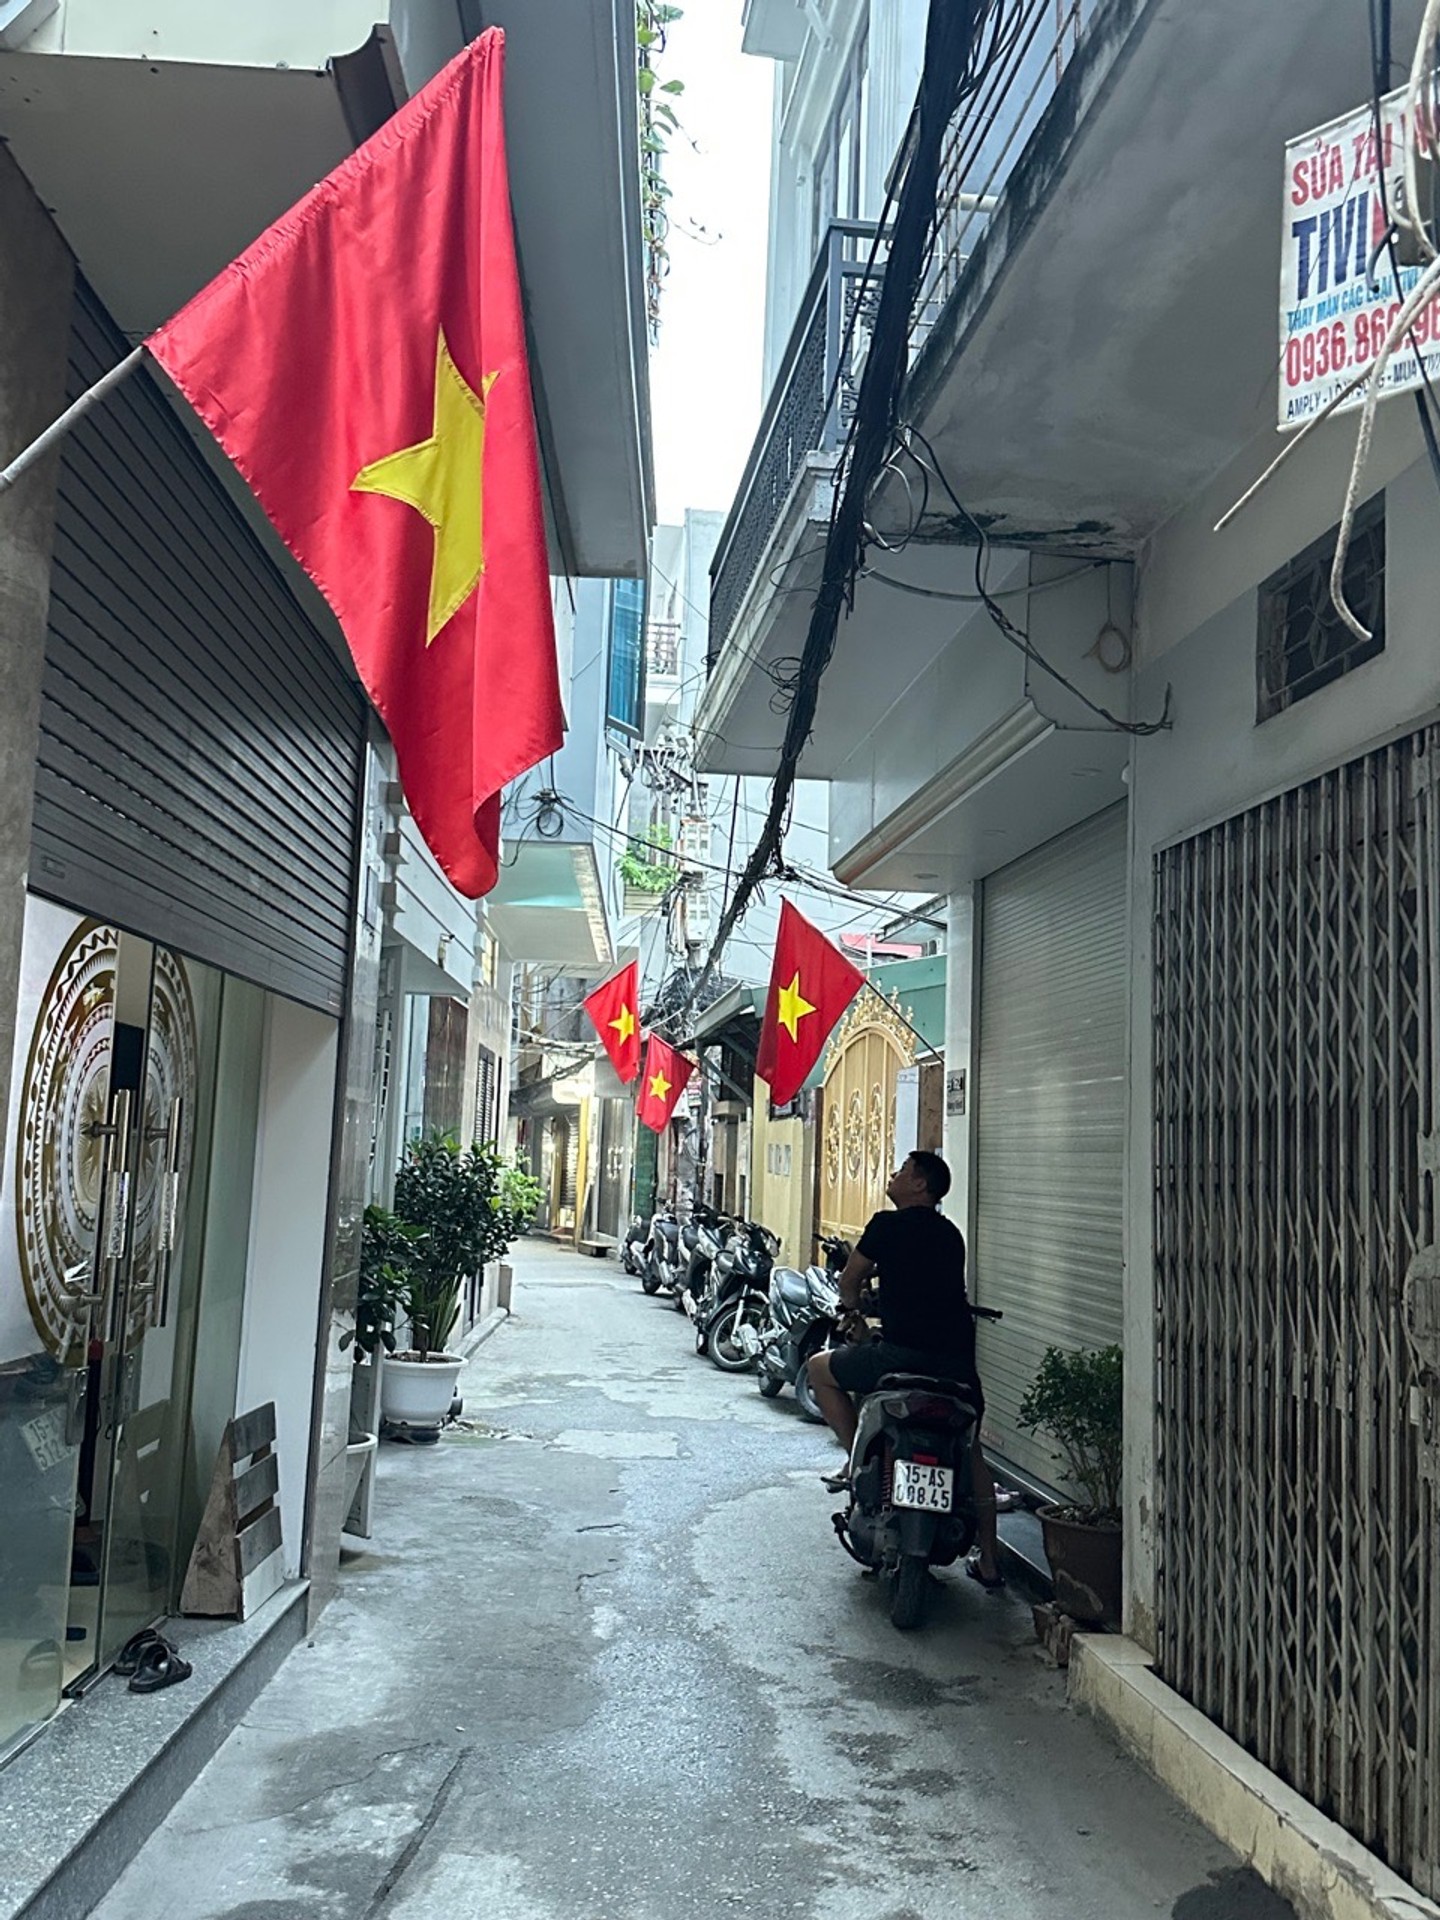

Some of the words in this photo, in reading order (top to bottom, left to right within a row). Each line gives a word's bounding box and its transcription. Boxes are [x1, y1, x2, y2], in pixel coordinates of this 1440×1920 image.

[1292, 137, 1344, 206] SỬA
[1292, 191, 1369, 301] TIVI
[1286, 306, 1315, 332] THAY
[1287, 390, 1321, 419] AMPLY
[905, 1466, 945, 1487] 15-AS
